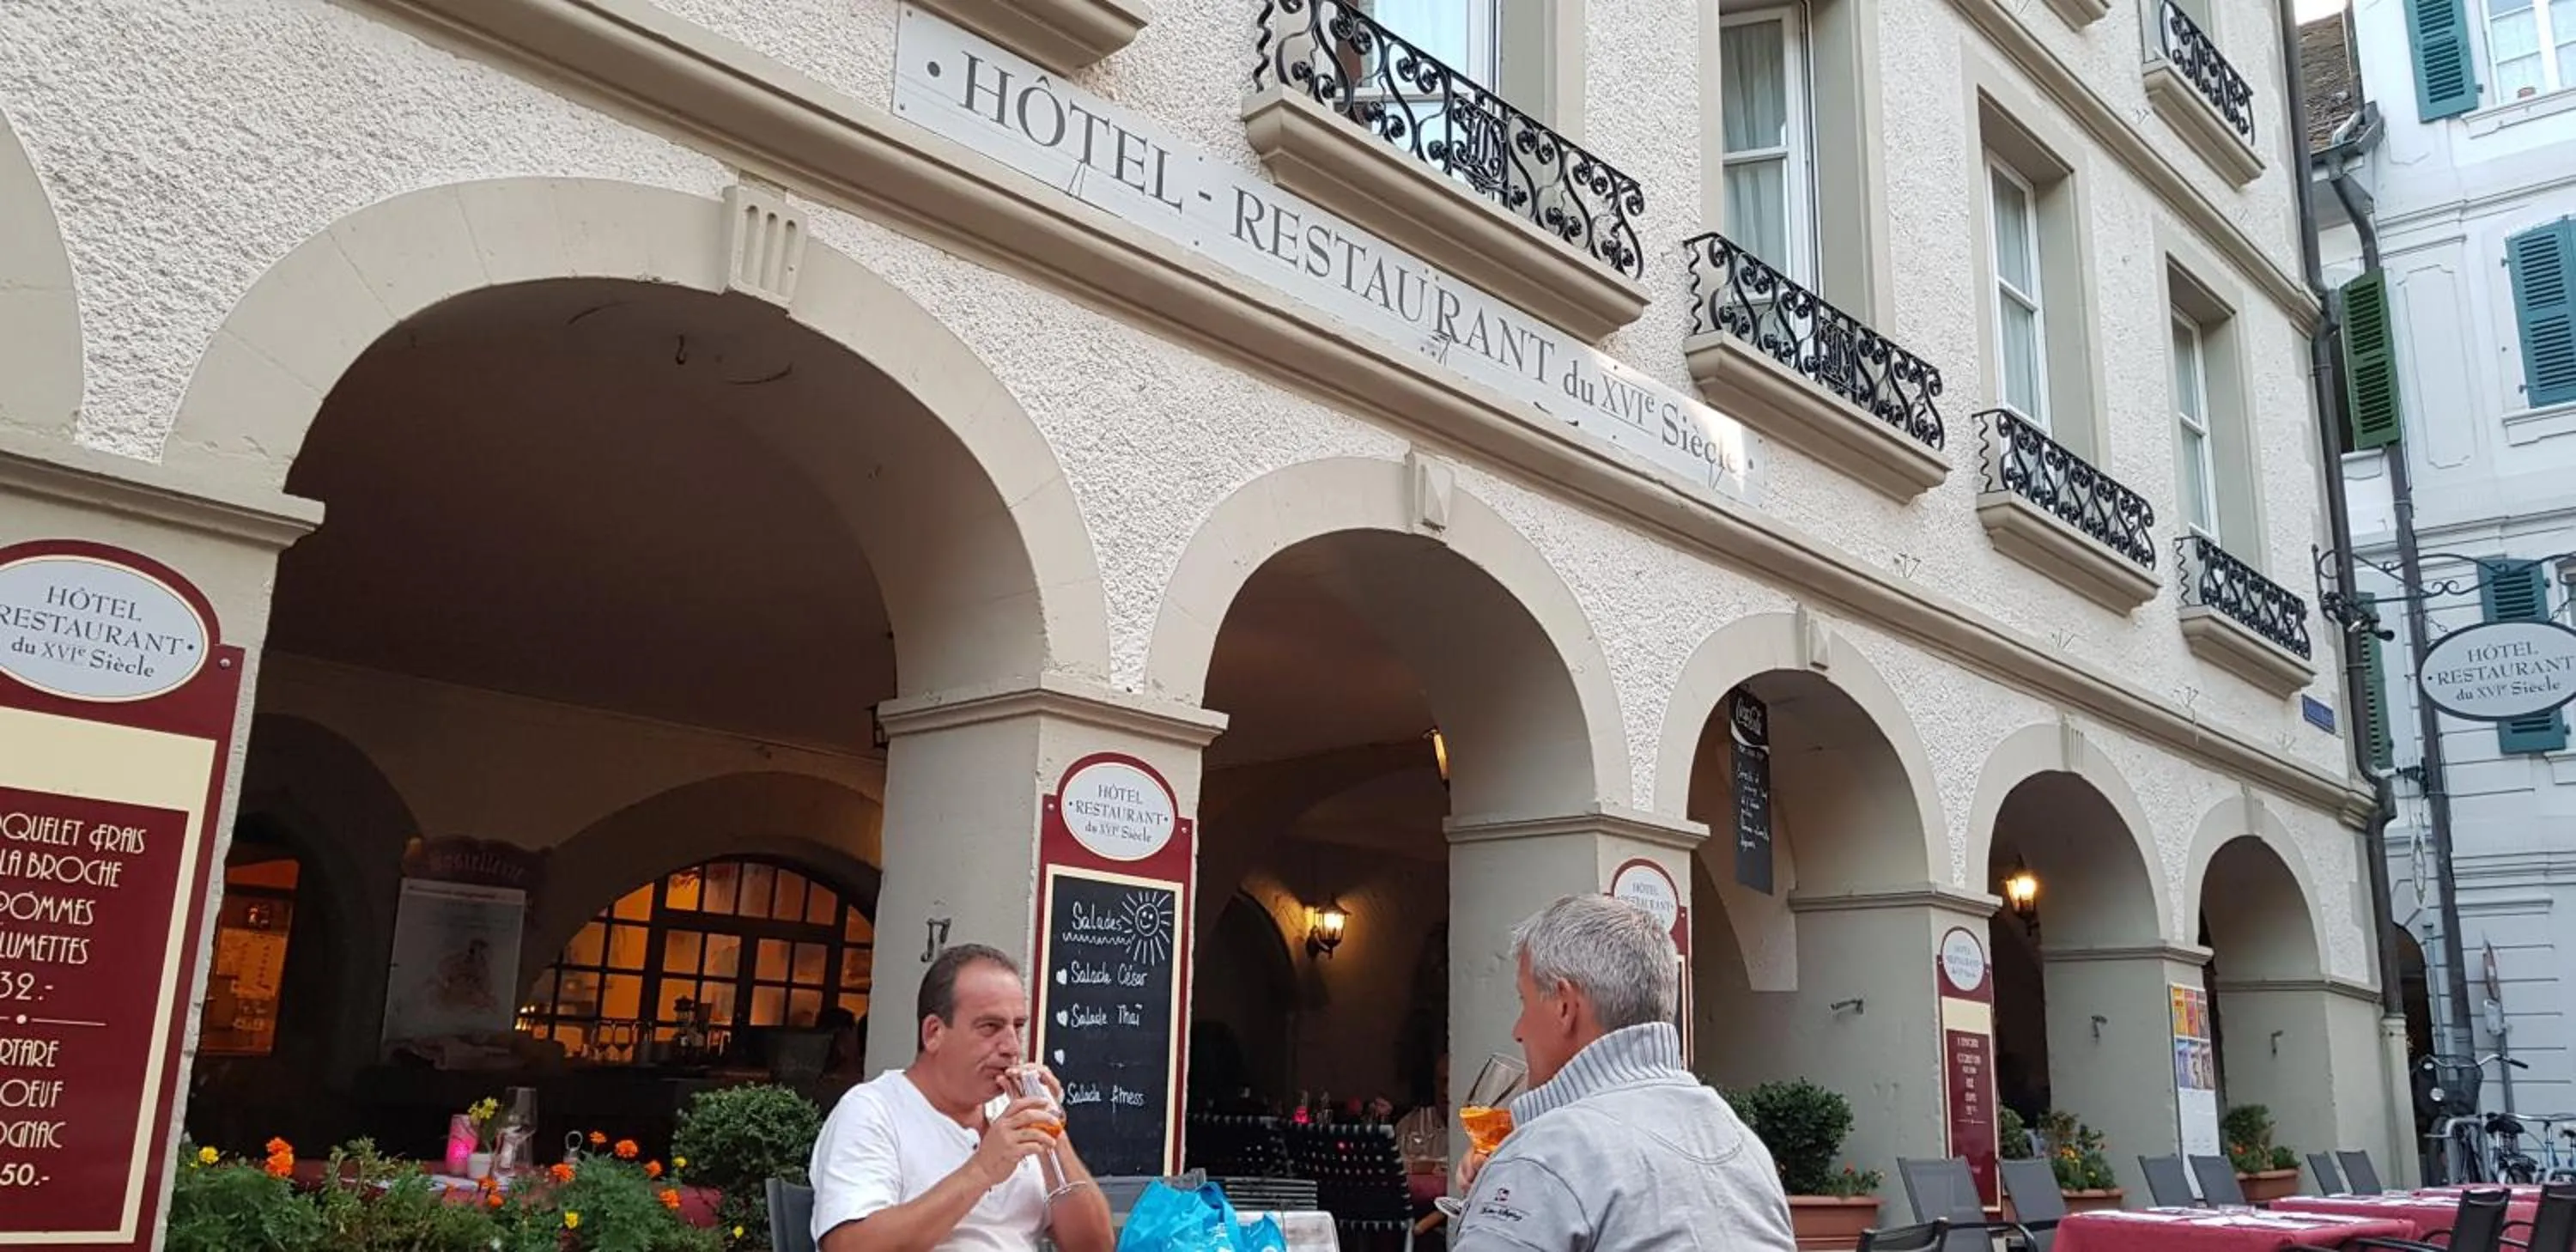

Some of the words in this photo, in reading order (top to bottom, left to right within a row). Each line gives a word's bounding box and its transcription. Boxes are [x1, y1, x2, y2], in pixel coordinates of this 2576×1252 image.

[959, 51, 1183, 215] HÔTEL
[1231, 185, 1555, 384] RESTAURANT
[1563, 360, 1595, 406] du
[46, 585, 142, 623] HÔTEL
[0, 604, 185, 655] RESTAURANT
[11, 636, 35, 655] du
[89, 648, 155, 678] Siècle
[2468, 641, 2540, 663] HÔTEL
[2437, 655, 2575, 685] RESTAURANT
[2456, 689, 2474, 701] du
[1098, 783, 1143, 804] HÔTEL
[1076, 799, 1163, 825] RESTAURANT
[0, 812, 85, 846] QUELET
[88, 824, 147, 854] FRAIS
[26, 852, 122, 887] BROCHE
[1072, 901, 1122, 931] Salades
[1071, 960, 1112, 984] Salade
[1117, 963, 1148, 987] César
[1071, 1003, 1108, 1028] Salade
[1066, 1082, 1102, 1105] Salade
[0, 1121, 66, 1149] GNAC
